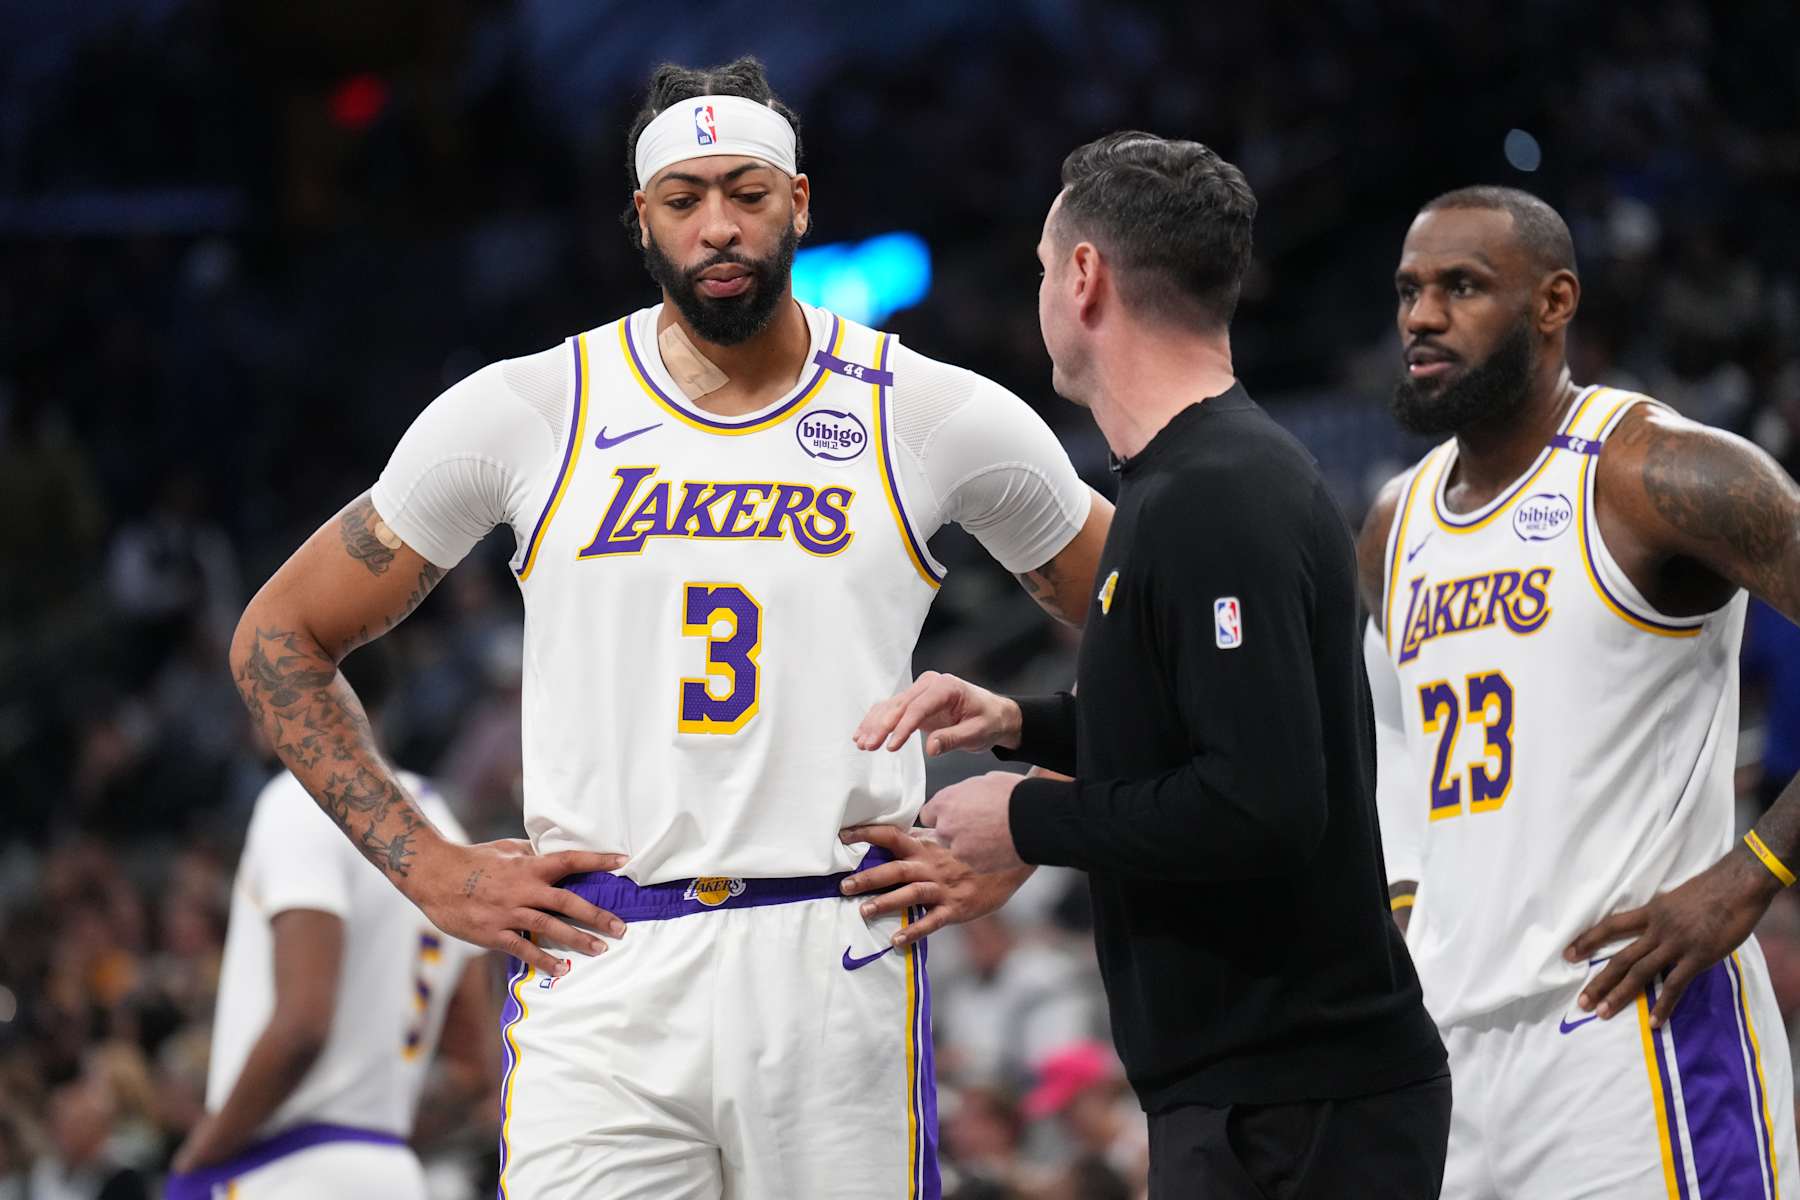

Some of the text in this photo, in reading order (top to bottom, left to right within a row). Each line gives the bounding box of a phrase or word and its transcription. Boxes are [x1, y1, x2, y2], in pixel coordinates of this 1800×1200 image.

[843, 363, 865, 379] 44
[803, 421, 863, 448] bibigo
[813, 439, 839, 450] 비비고
[577, 465, 855, 559] LAKERS
[1519, 506, 1569, 527] bibigo
[1398, 567, 1554, 665] LAKERS
[679, 582, 762, 734] 3
[1418, 670, 1514, 821] 23
[683, 875, 747, 901] LAKERS
